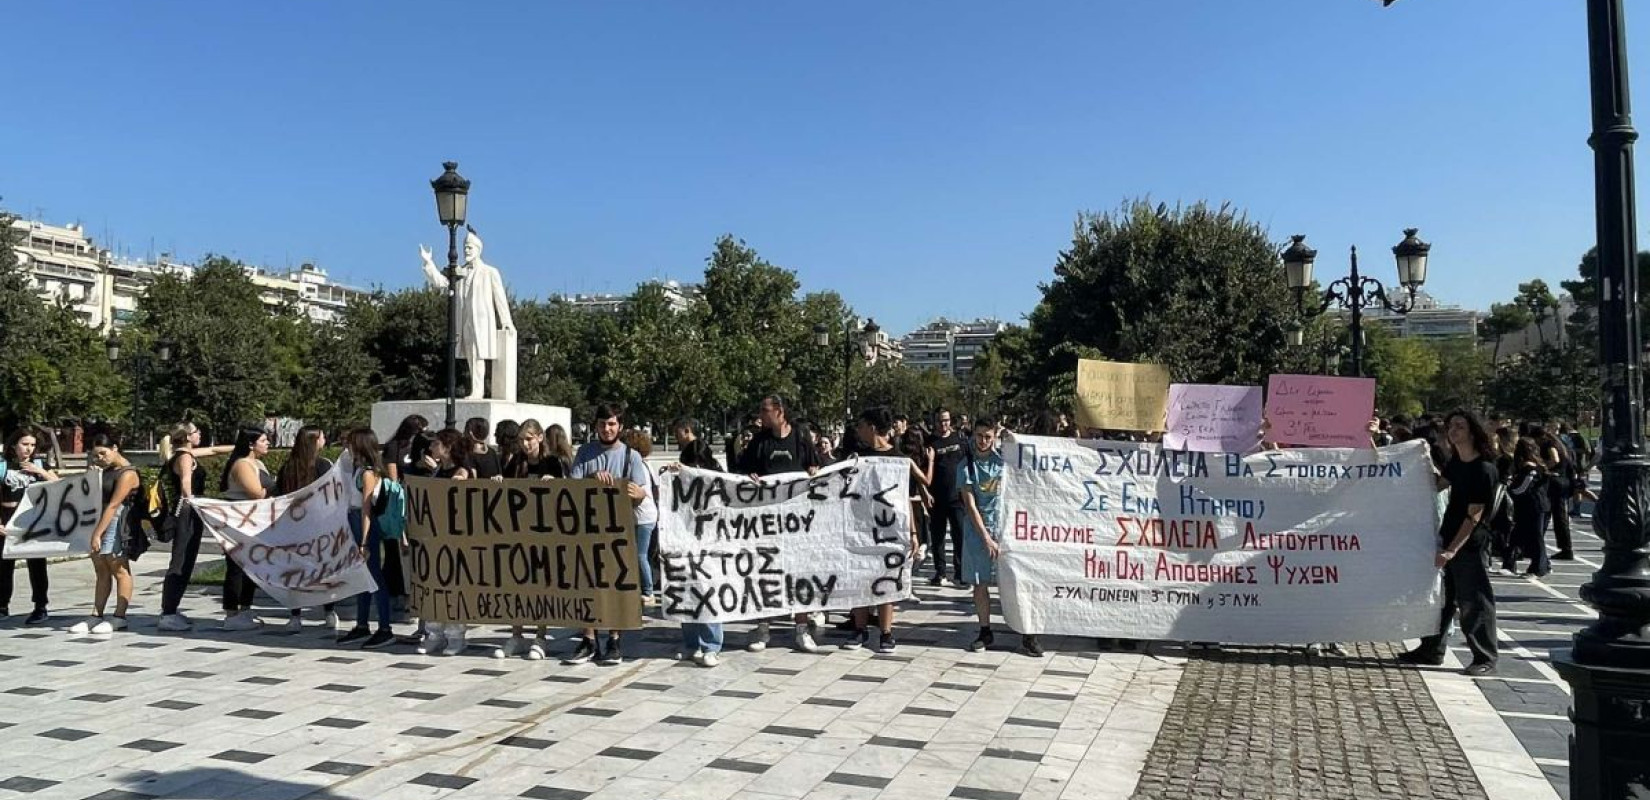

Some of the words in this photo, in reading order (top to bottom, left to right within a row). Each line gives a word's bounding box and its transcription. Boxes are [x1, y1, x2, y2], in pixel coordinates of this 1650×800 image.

[1095, 448, 1209, 478] ΣΧΟΛΕΙΑ
[1226, 452, 1254, 477] ΘΑ
[407, 485, 437, 537] ΝΑ
[448, 487, 625, 536] ΕΓΚΡΙΘΕΙ
[1122, 482, 1161, 514] ΕΝΑ
[1015, 511, 1094, 544] ΘΕΛΟΥΜΕ
[1116, 517, 1218, 549] ΣΧΟΛΕΙΑ
[1242, 521, 1360, 551] ΛΕΙΤΟΥΡΓΙΚΑ
[436, 539, 637, 591] ΟΛΙΓΟΜΕΛΕΣ
[662, 547, 784, 581] ΕΚΤΟΣ
[1084, 549, 1110, 580] ΚΑΙ
[1116, 551, 1144, 581] ΟΧΙ
[1155, 552, 1258, 584] ΑΠΟΘΗΚΕΣ
[1267, 555, 1339, 584] ΨΥΧΩΝ
[664, 574, 837, 618] ΣΧΟΛΕΙΟΥ
